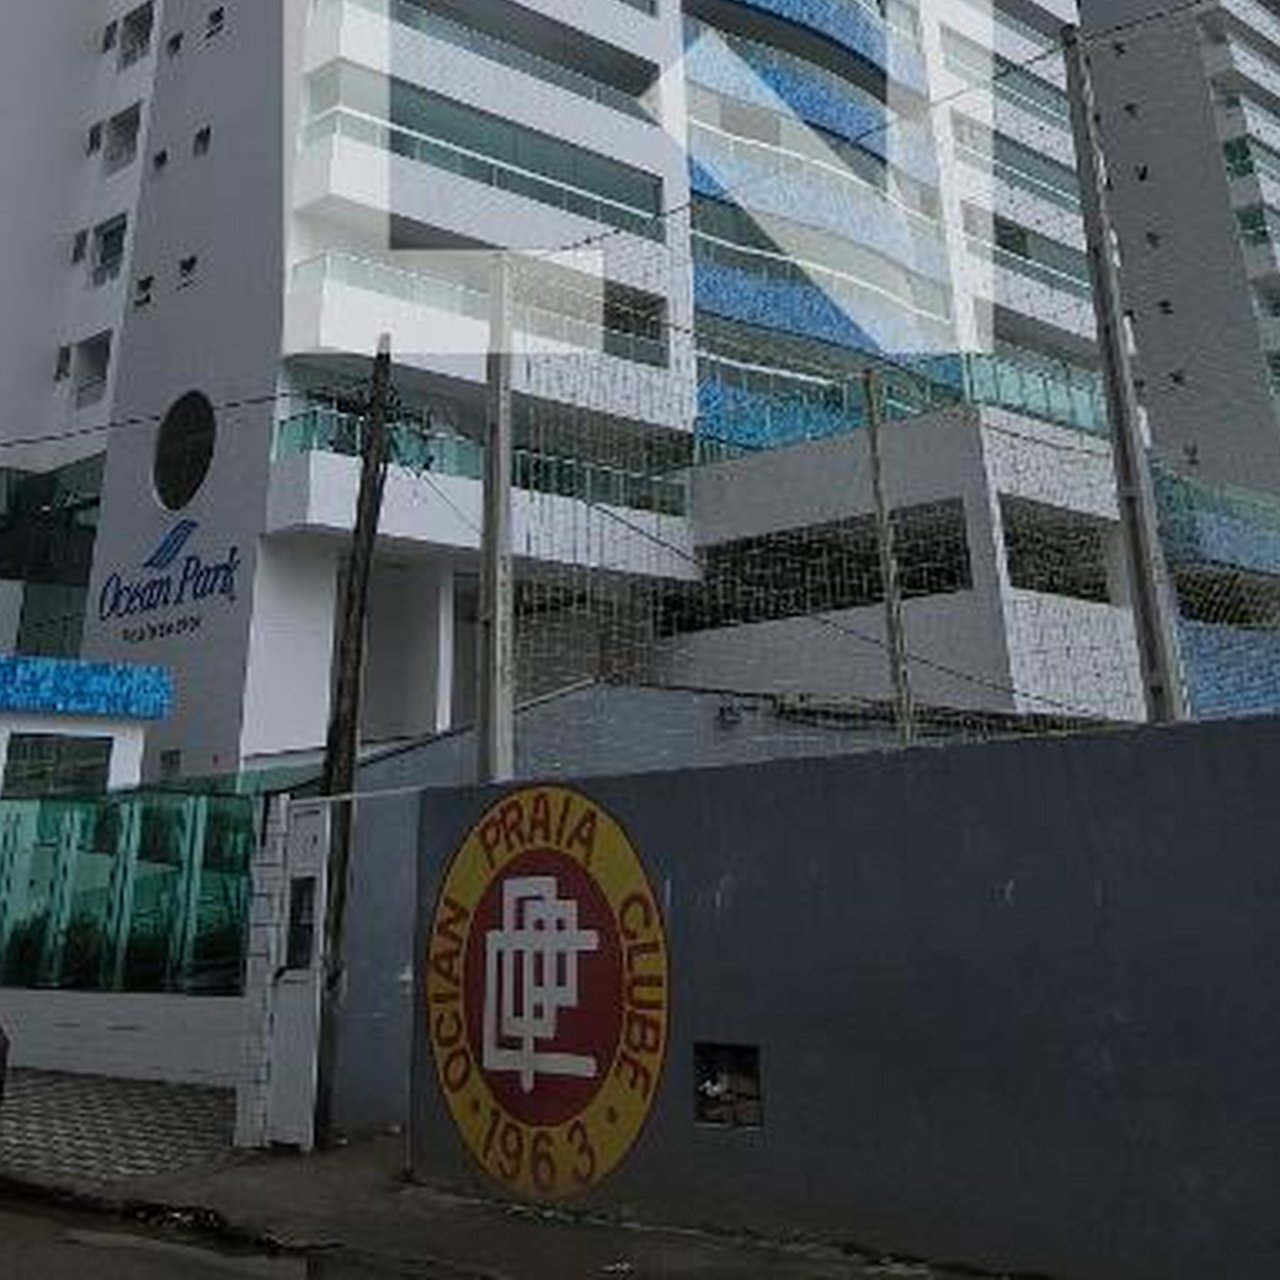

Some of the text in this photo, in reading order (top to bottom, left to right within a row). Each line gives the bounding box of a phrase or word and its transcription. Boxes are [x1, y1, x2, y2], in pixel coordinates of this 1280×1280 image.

[99, 545, 241, 620] Ocean Park
[432, 791, 664, 1100] OCIAN PRAIA CLUBE
[482, 1107, 597, 1195] 1963
